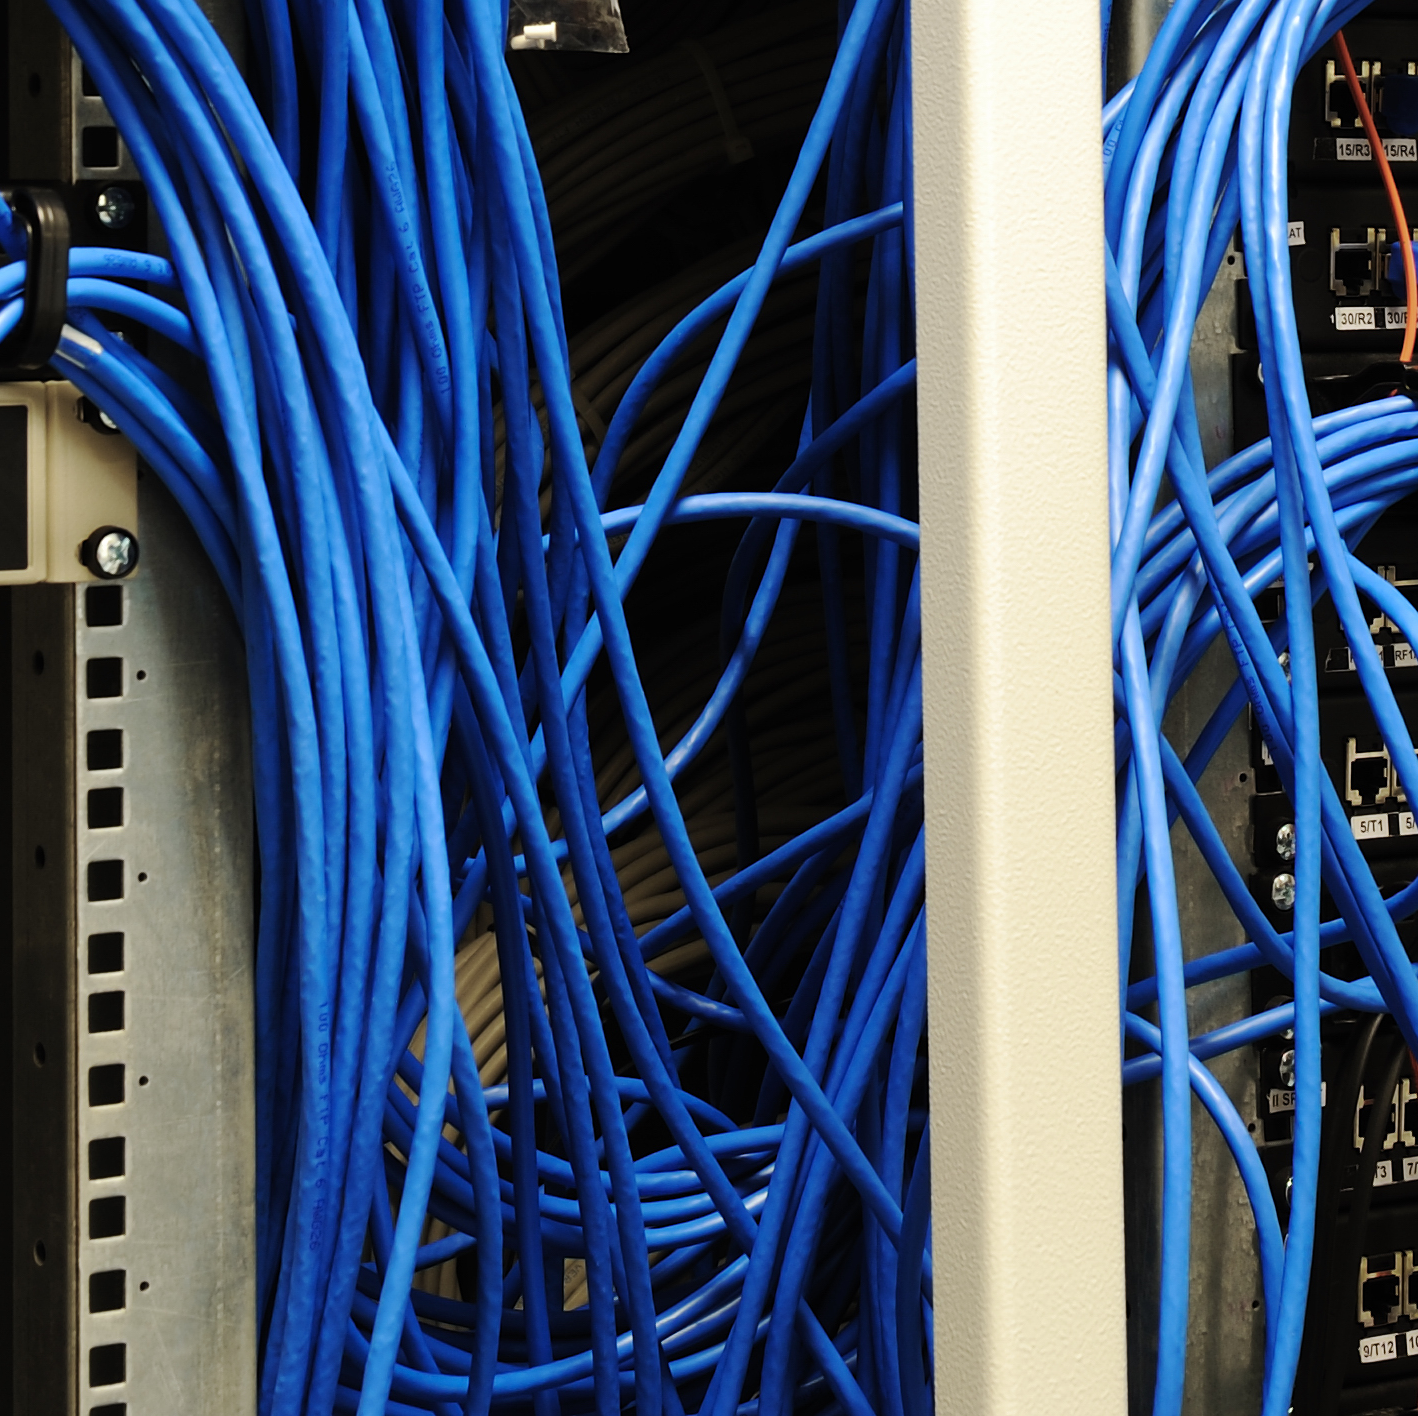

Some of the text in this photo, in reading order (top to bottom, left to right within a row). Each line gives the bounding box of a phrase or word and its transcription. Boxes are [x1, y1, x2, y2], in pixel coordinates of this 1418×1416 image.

[1339, 143, 1370, 157] 15/R3
[1384, 143, 1415, 157] 15/R4
[399, 221, 409, 233] 6
[412, 284, 429, 313] FTP
[1341, 312, 1372, 326] 30/R2
[426, 320, 441, 358] Ohms
[441, 366, 450, 394] 100
[1361, 819, 1383, 833] 5/T1
[318, 1042, 328, 1085] Ohms
[1363, 1341, 1394, 1358] 9/T12
